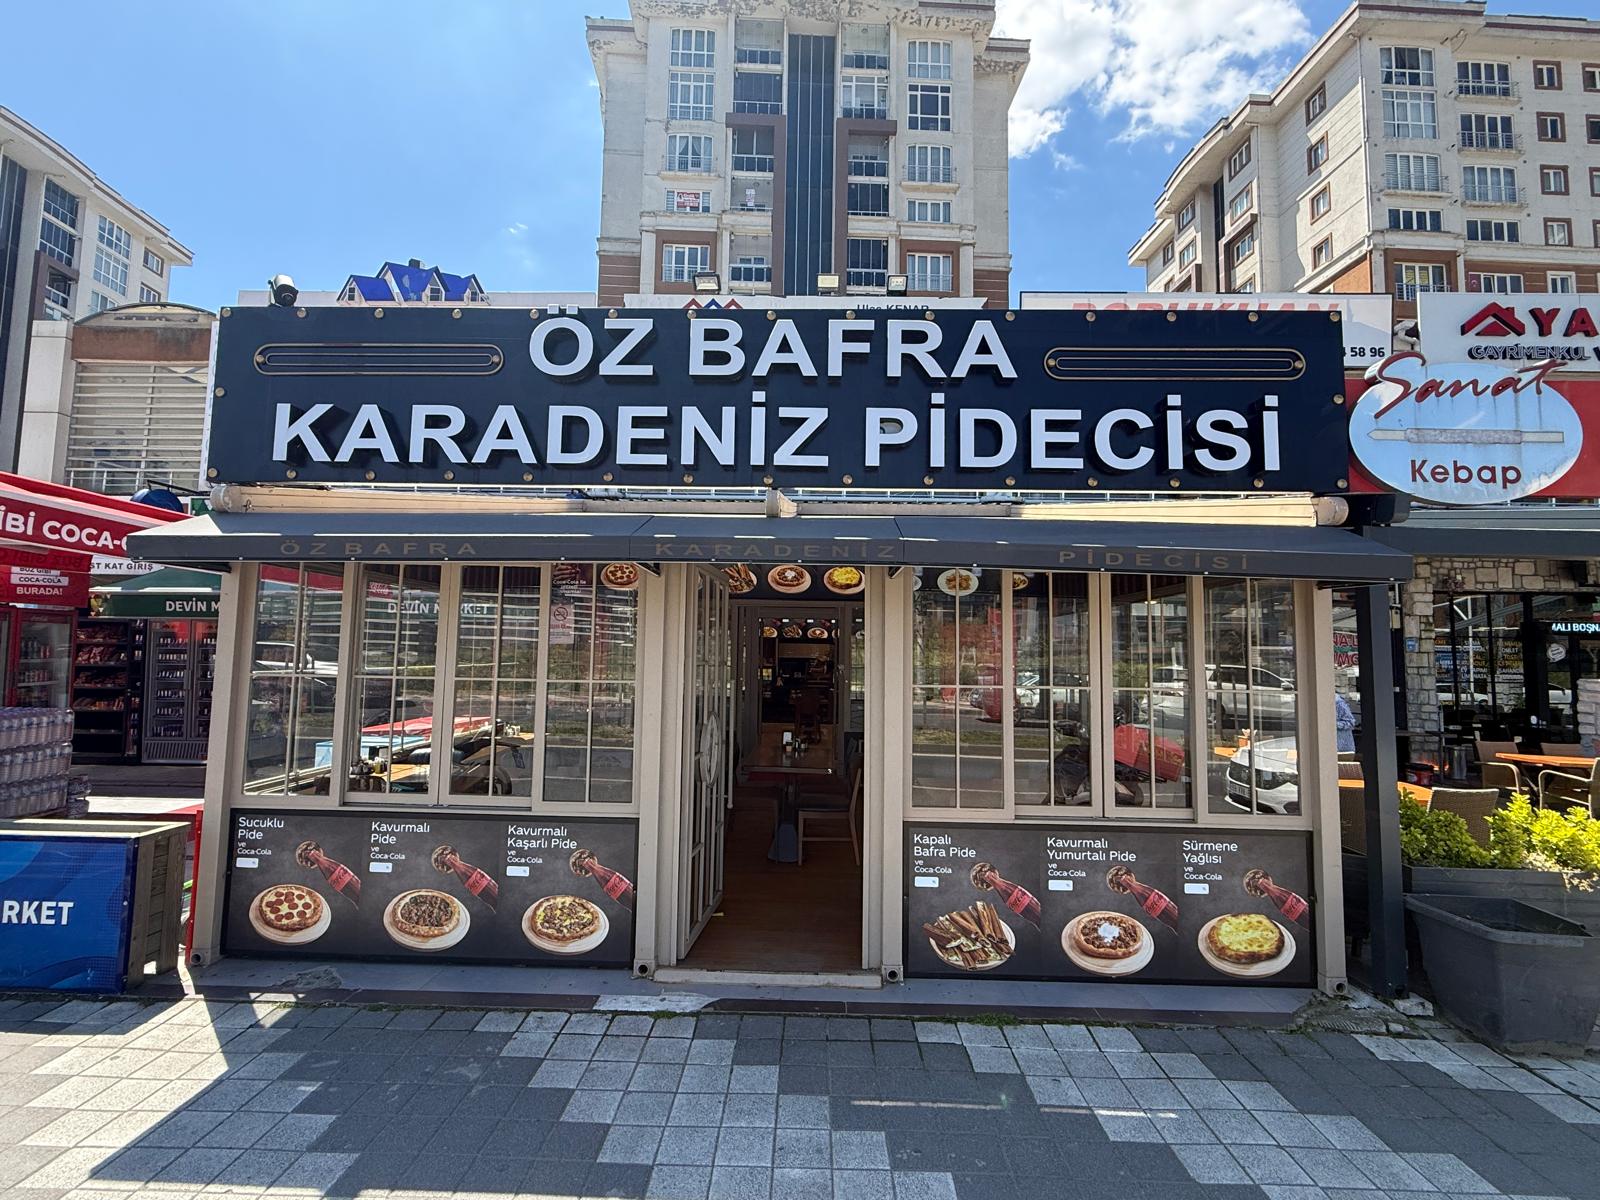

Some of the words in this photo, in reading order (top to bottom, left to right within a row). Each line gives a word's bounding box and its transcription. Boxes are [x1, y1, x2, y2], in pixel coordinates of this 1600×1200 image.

[1528, 307, 1599, 337] YA
[528, 303, 655, 378] ÖZ
[688, 317, 1019, 379] BAFRA
[1350, 346, 1366, 357] 58
[1370, 346, 1385, 357] 96
[1374, 351, 1568, 419] Sanat
[272, 390, 829, 468] KARADENİZ
[864, 392, 1281, 472] PİDECİSİ
[1411, 459, 1522, 489] Kebap
[280, 539, 327, 556] ÖZ
[344, 542, 477, 556] BAFRA
[655, 541, 897, 559] KARADENİZ
[1058, 548, 1248, 570] PİDECİSİ
[105, 562, 124, 570] KAT
[18, 576, 62, 584] COCA-COLA
[16, 586, 63, 596] BURADA!
[165, 597, 207, 612] DEVİN
[238, 816, 284, 828] Sucuklu
[371, 821, 430, 833] Kavurmalı
[237, 829, 263, 840] Pide
[508, 825, 567, 837] Kavurmalı
[370, 833, 397, 844] Pide
[507, 837, 548, 850] Kaşarlı
[551, 838, 577, 849] Pide
[913, 834, 952, 846] Kapalı
[1047, 837, 1108, 849] Kavurmalı
[1182, 839, 1238, 852] Sürmene
[237, 848, 272, 856] Coca-Cola
[370, 852, 406, 860] Coca-Cola
[914, 847, 946, 857] Bafra
[949, 847, 976, 858] Pide
[1047, 849, 1106, 861] Yumurtalı
[1109, 851, 1137, 862] Pide
[507, 856, 543, 864] Coca-Cola
[1182, 852, 1222, 865] Yağlısı
[914, 866, 952, 874] Coca-Cola
[1048, 869, 1086, 877] Coca-Cola
[1184, 873, 1223, 881] Coca-Cola
[0, 899, 74, 926] RKET
